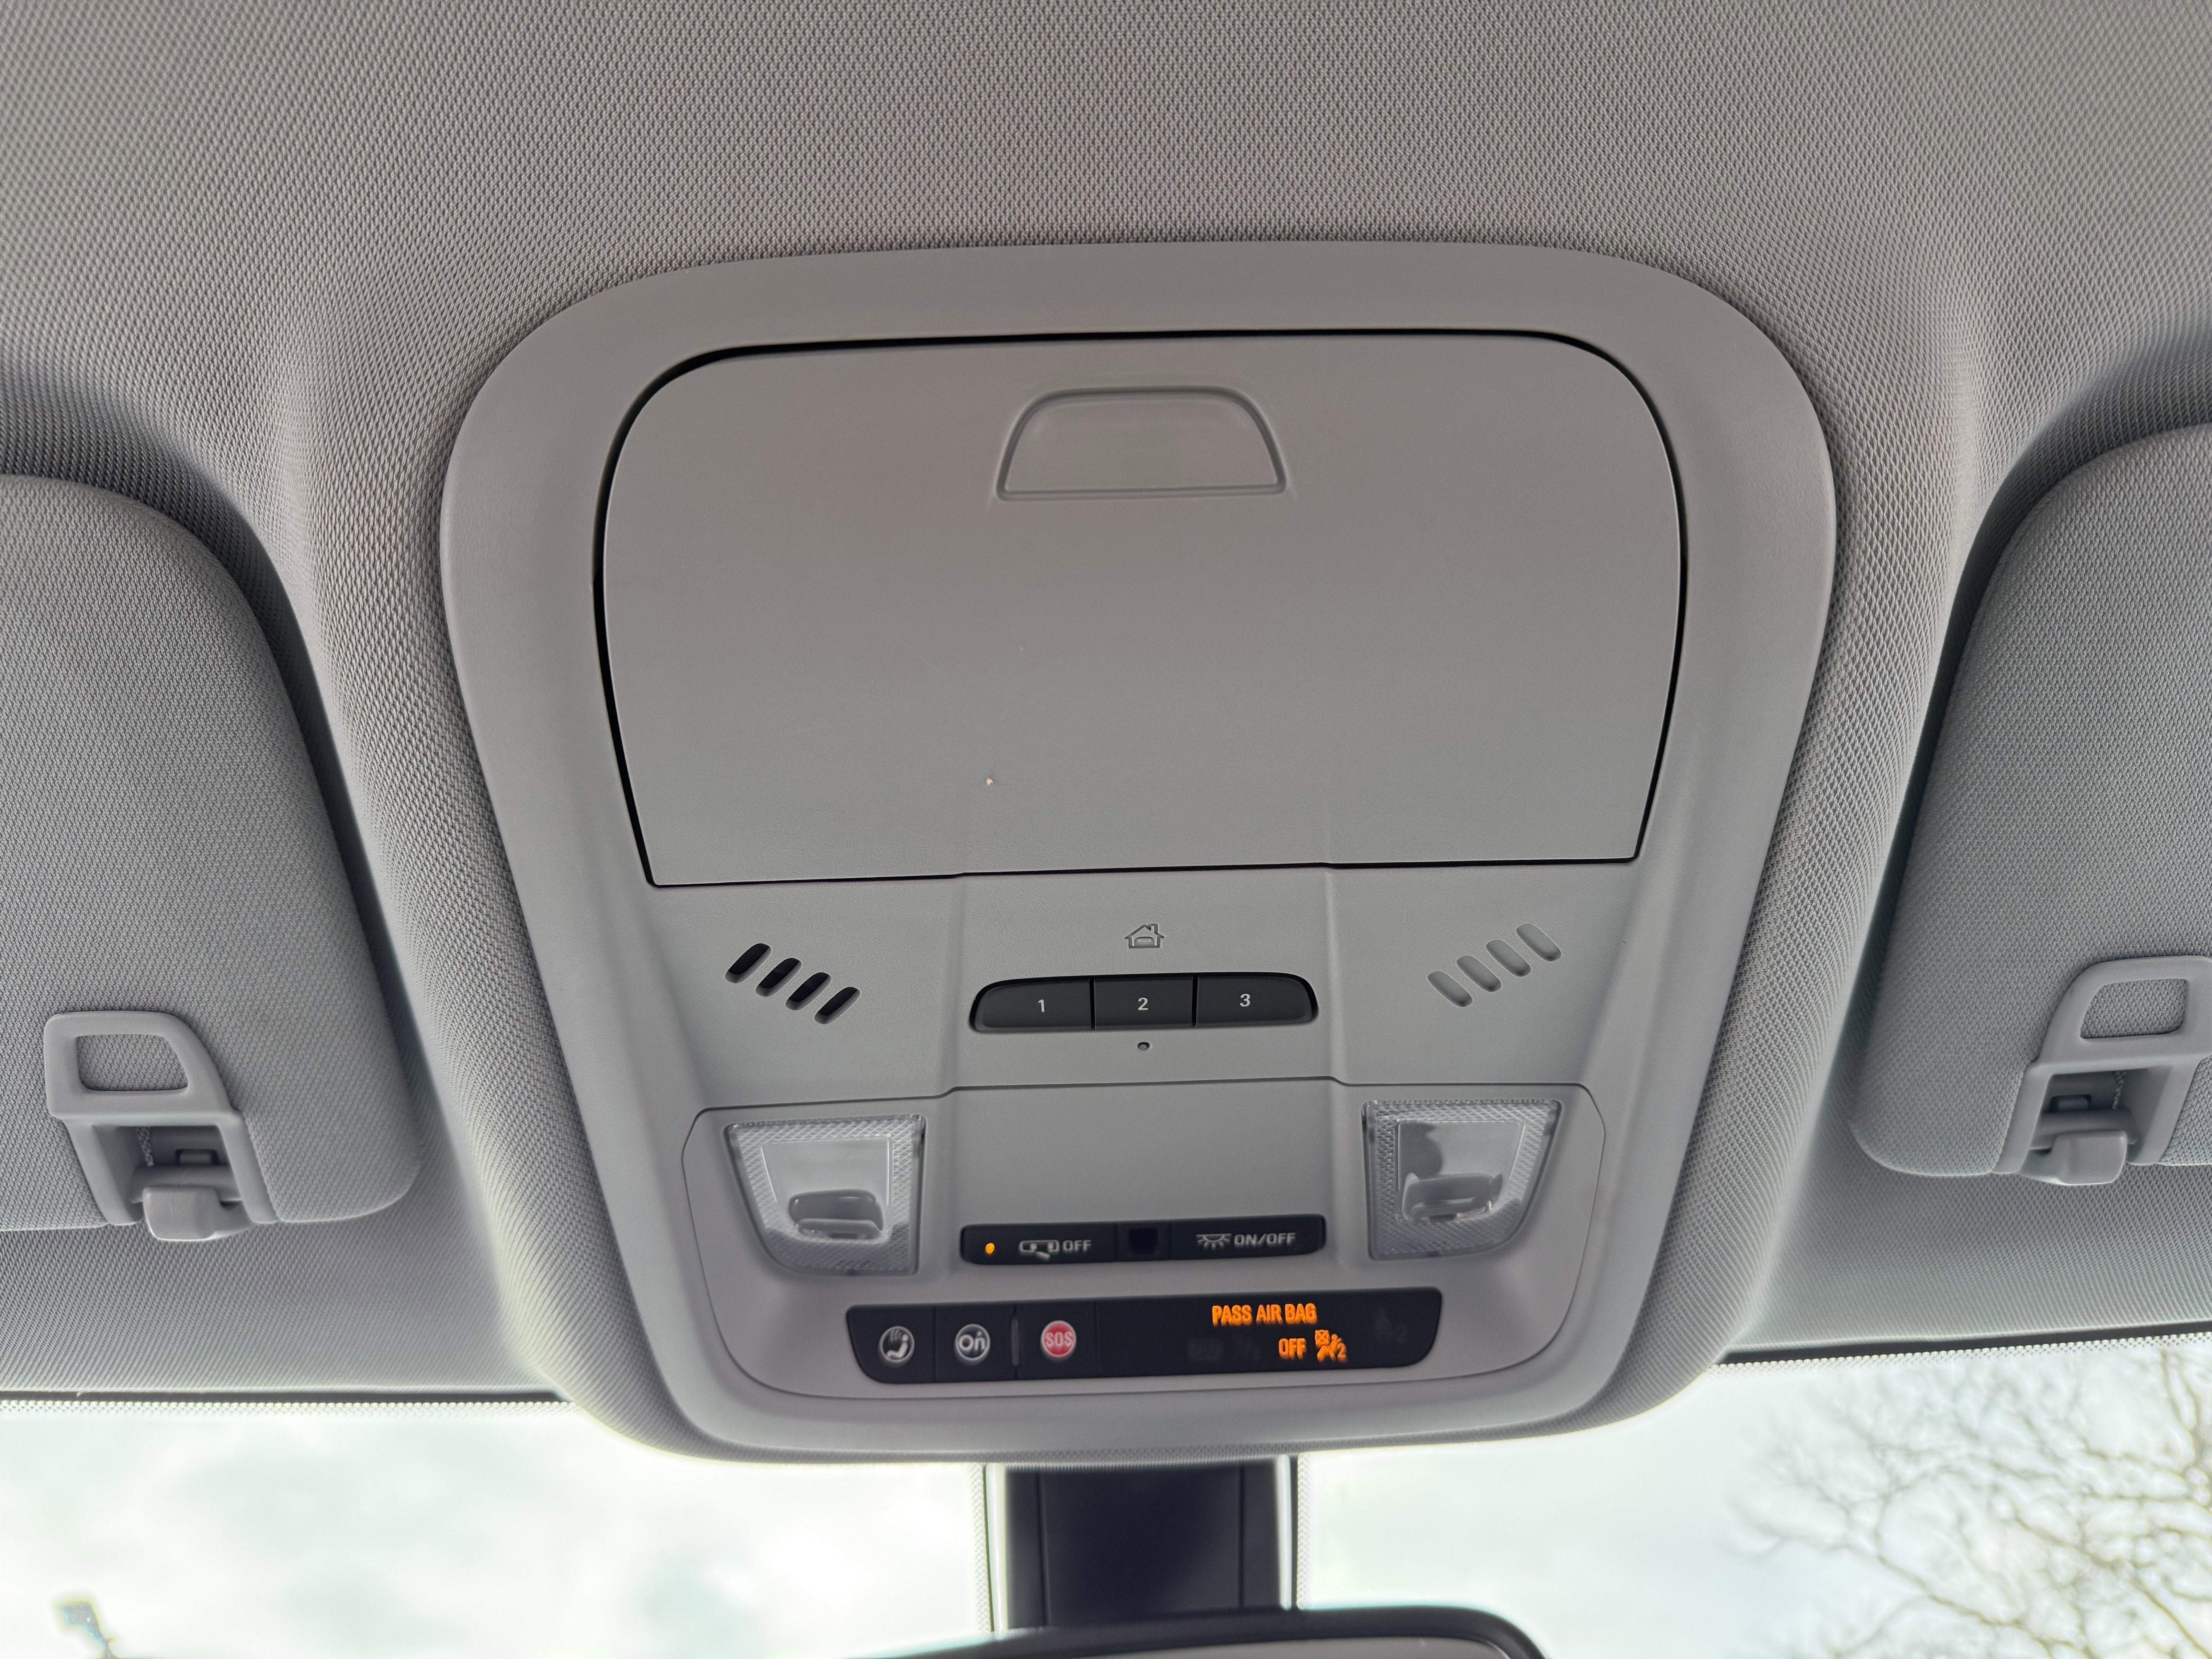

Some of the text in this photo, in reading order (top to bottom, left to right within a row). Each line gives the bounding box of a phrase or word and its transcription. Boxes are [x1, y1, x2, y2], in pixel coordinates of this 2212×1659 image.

[1038, 993, 1251, 1013] 1 2 3
[1063, 1240, 1091, 1252] OFF
[1234, 1232, 1295, 1246] ON/OFF
[1212, 1303, 1317, 1326] PASS AIR BAG
[1046, 1331, 1072, 1347] SOS
[1278, 1338, 1307, 1359] OFF
